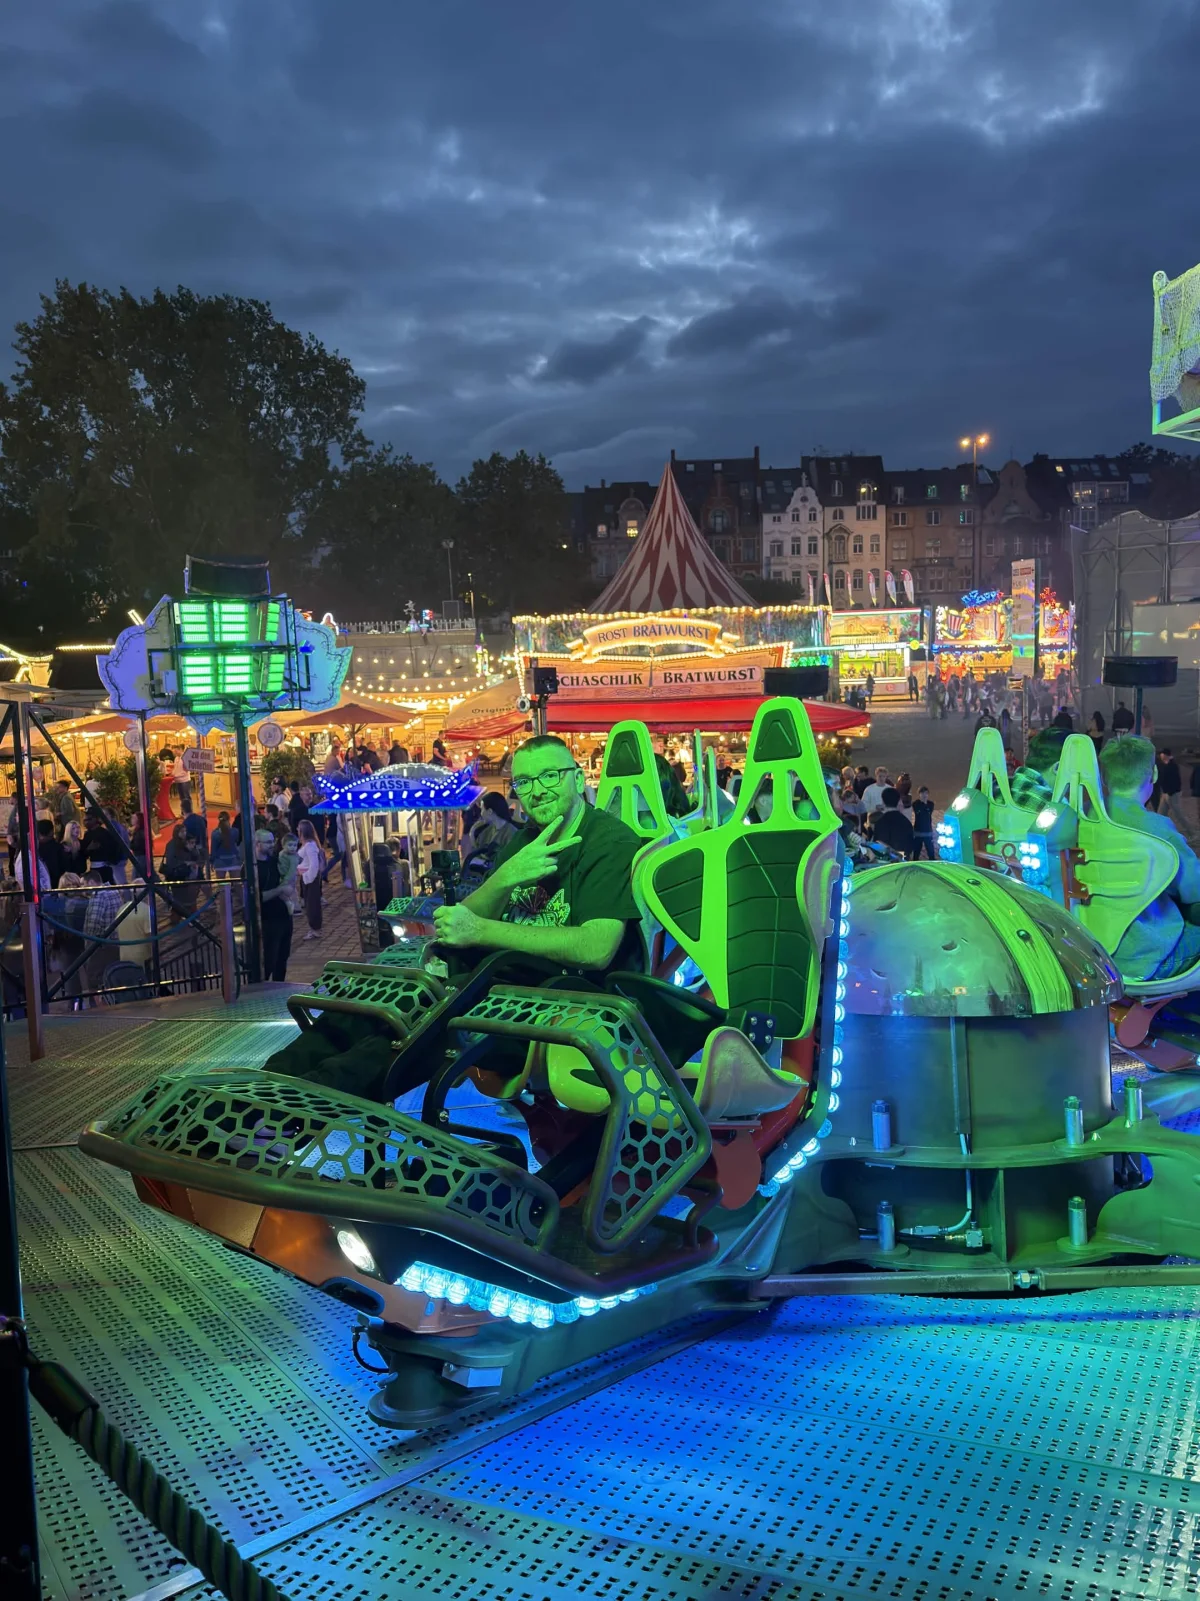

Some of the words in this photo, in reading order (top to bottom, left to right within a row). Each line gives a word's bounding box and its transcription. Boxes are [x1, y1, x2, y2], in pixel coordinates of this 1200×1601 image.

[598, 628, 627, 643] ROST
[633, 624, 710, 640] BRATWURST
[663, 667, 756, 684] BRATWURST
[370, 780, 411, 790] KASSE
